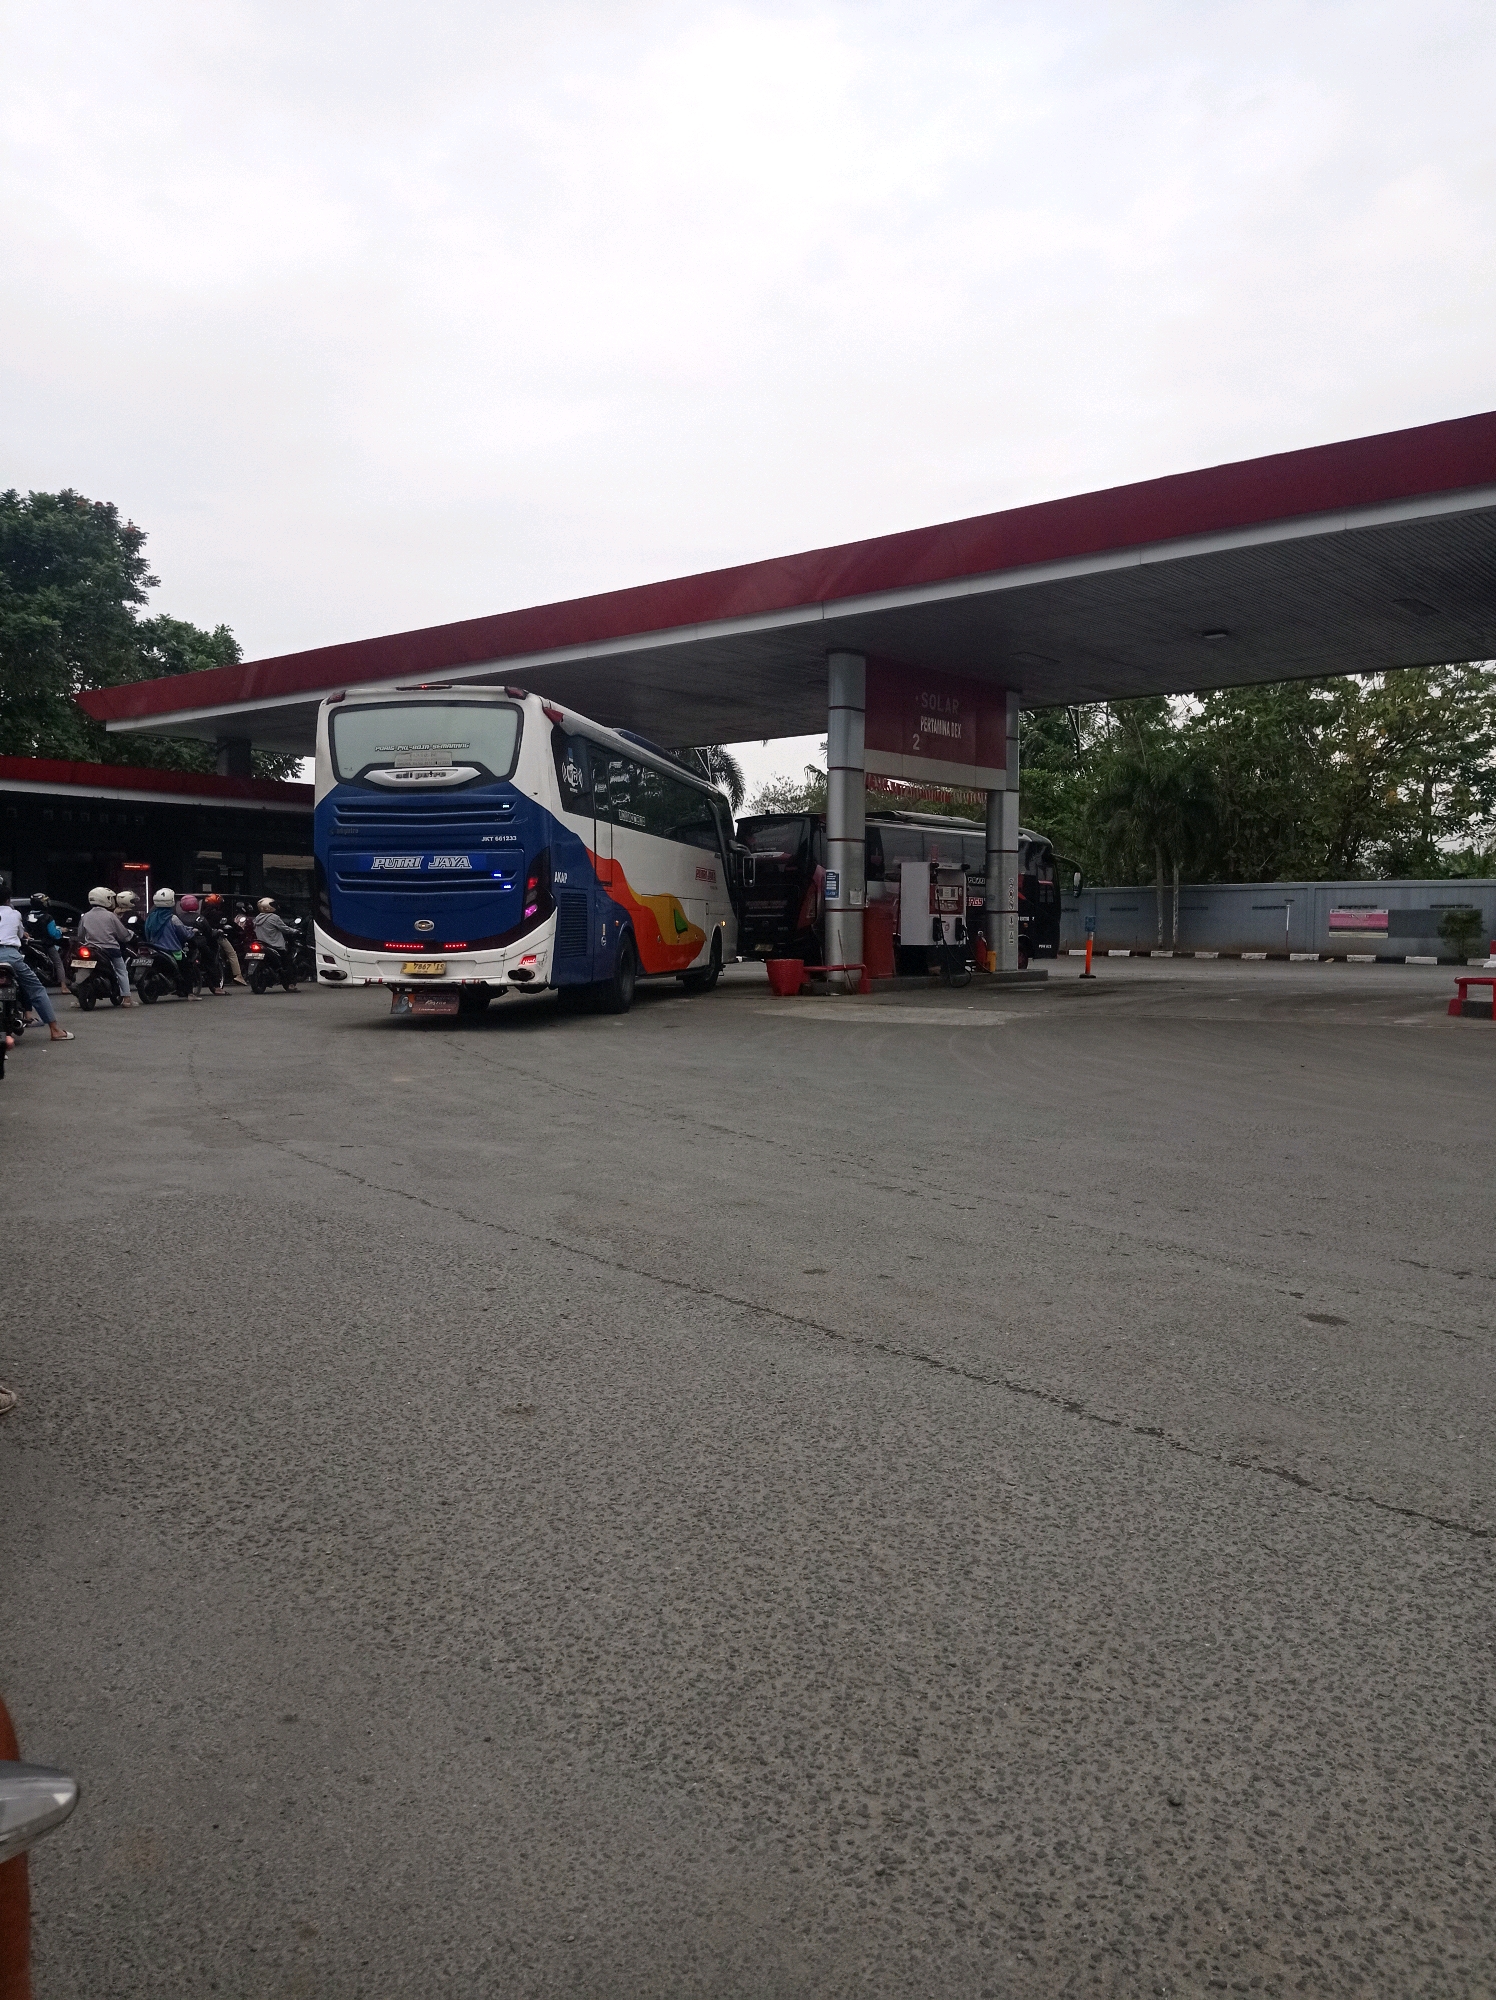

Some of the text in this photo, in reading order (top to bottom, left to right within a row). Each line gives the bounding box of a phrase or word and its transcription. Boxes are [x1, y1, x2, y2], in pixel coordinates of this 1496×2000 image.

[921, 692, 959, 714] SOLAR
[920, 716, 962, 739] PERTAMINA DEX
[912, 733, 920, 750] 2
[371, 856, 473, 870] PUTRI JAYA
[554, 871, 568, 884] AKAP
